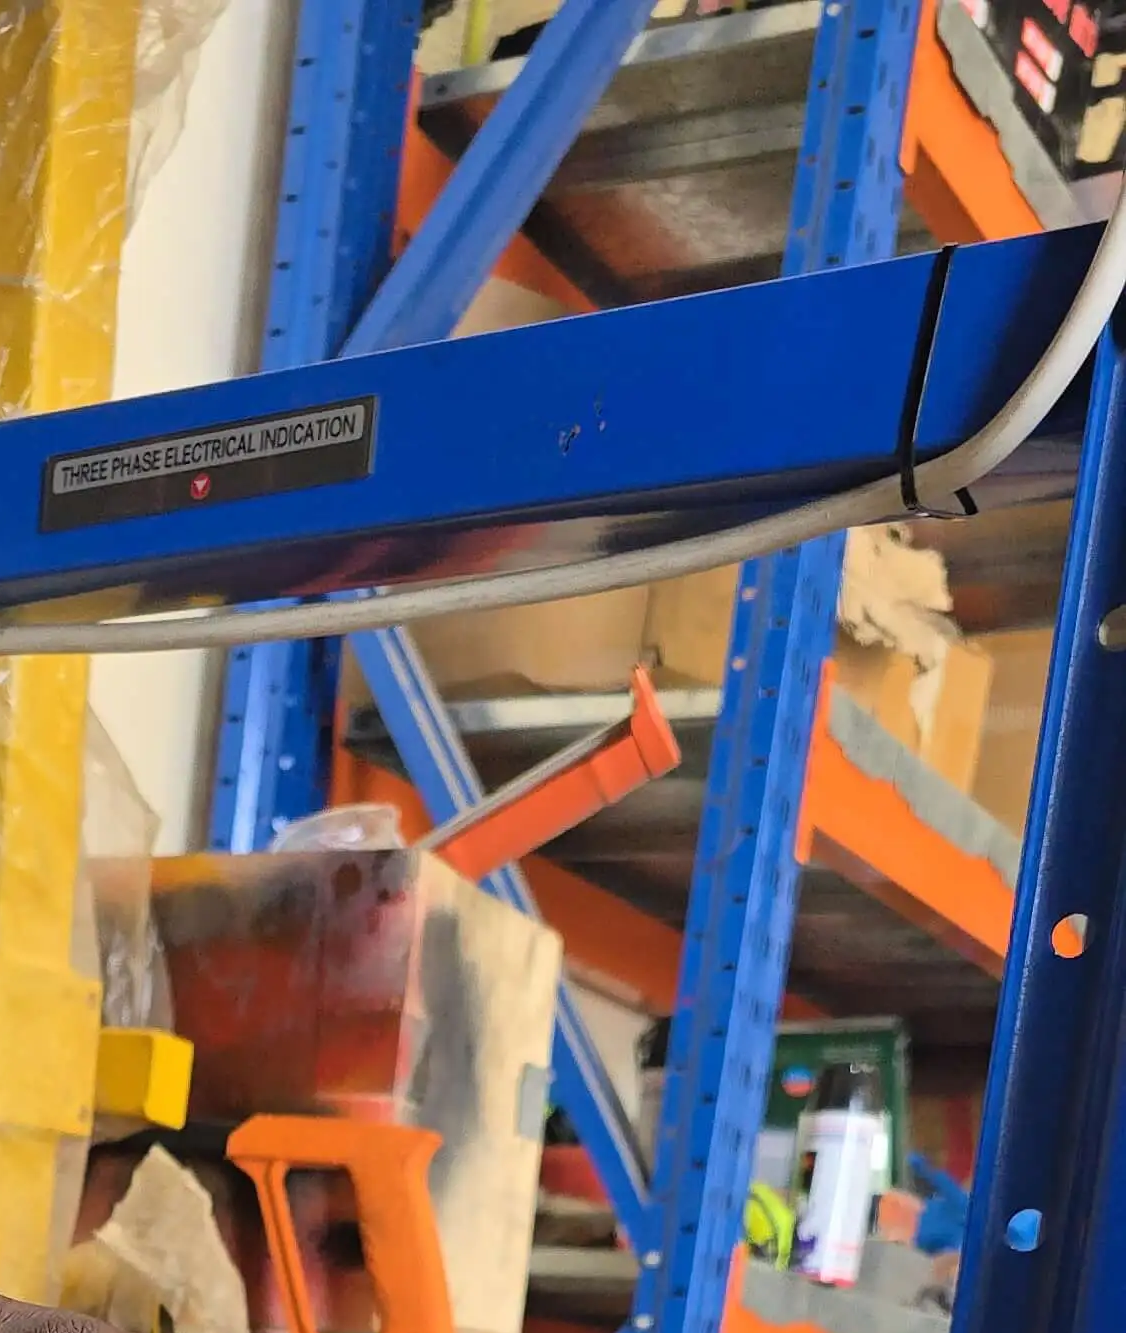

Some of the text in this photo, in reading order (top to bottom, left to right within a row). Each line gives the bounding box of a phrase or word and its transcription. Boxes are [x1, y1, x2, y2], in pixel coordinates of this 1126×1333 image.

[62, 413, 356, 487] THREE PHASE ELECTRICAL INDICATION
